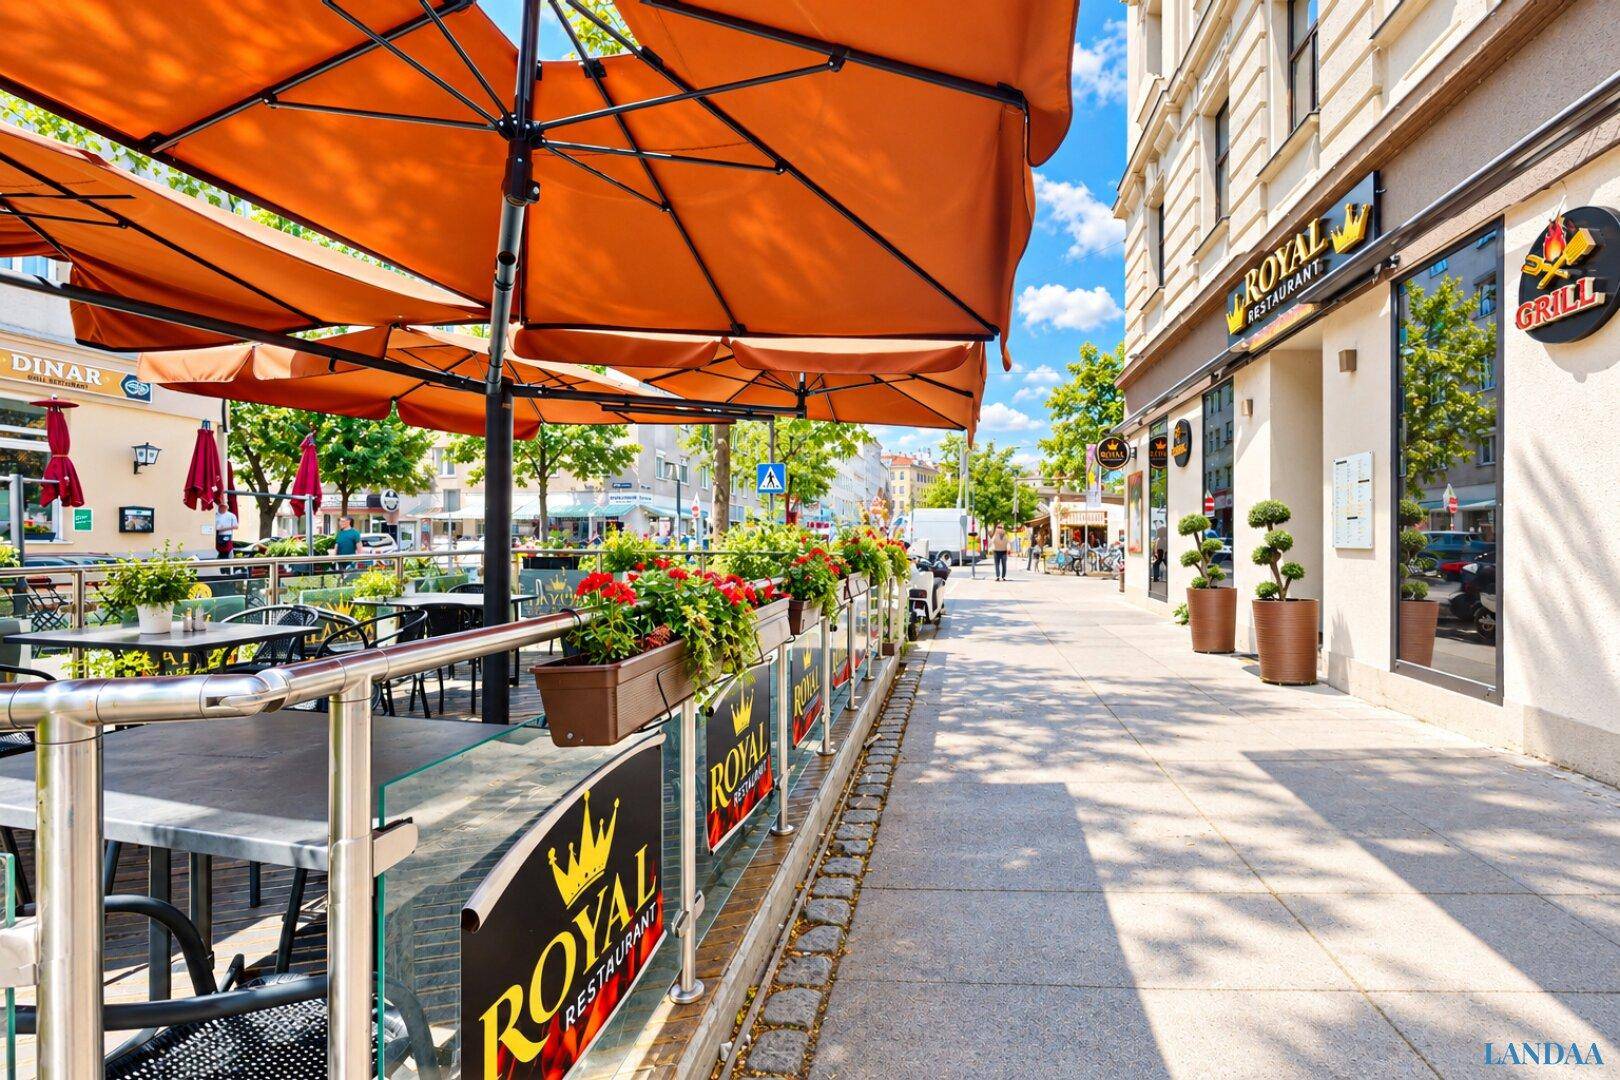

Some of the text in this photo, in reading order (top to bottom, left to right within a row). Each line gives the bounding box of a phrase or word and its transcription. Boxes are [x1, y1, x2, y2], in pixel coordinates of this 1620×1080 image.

[1244, 218, 1328, 307] ROYAL
[1248, 259, 1322, 323] RESTAURANT
[1515, 277, 1605, 331] GRILL
[11, 353, 102, 386] DINAR
[794, 665, 820, 717] ROYAL
[710, 722, 768, 814] ROYAL
[478, 844, 657, 1080] ROYAL
[565, 902, 657, 1031] RESTAURANT
